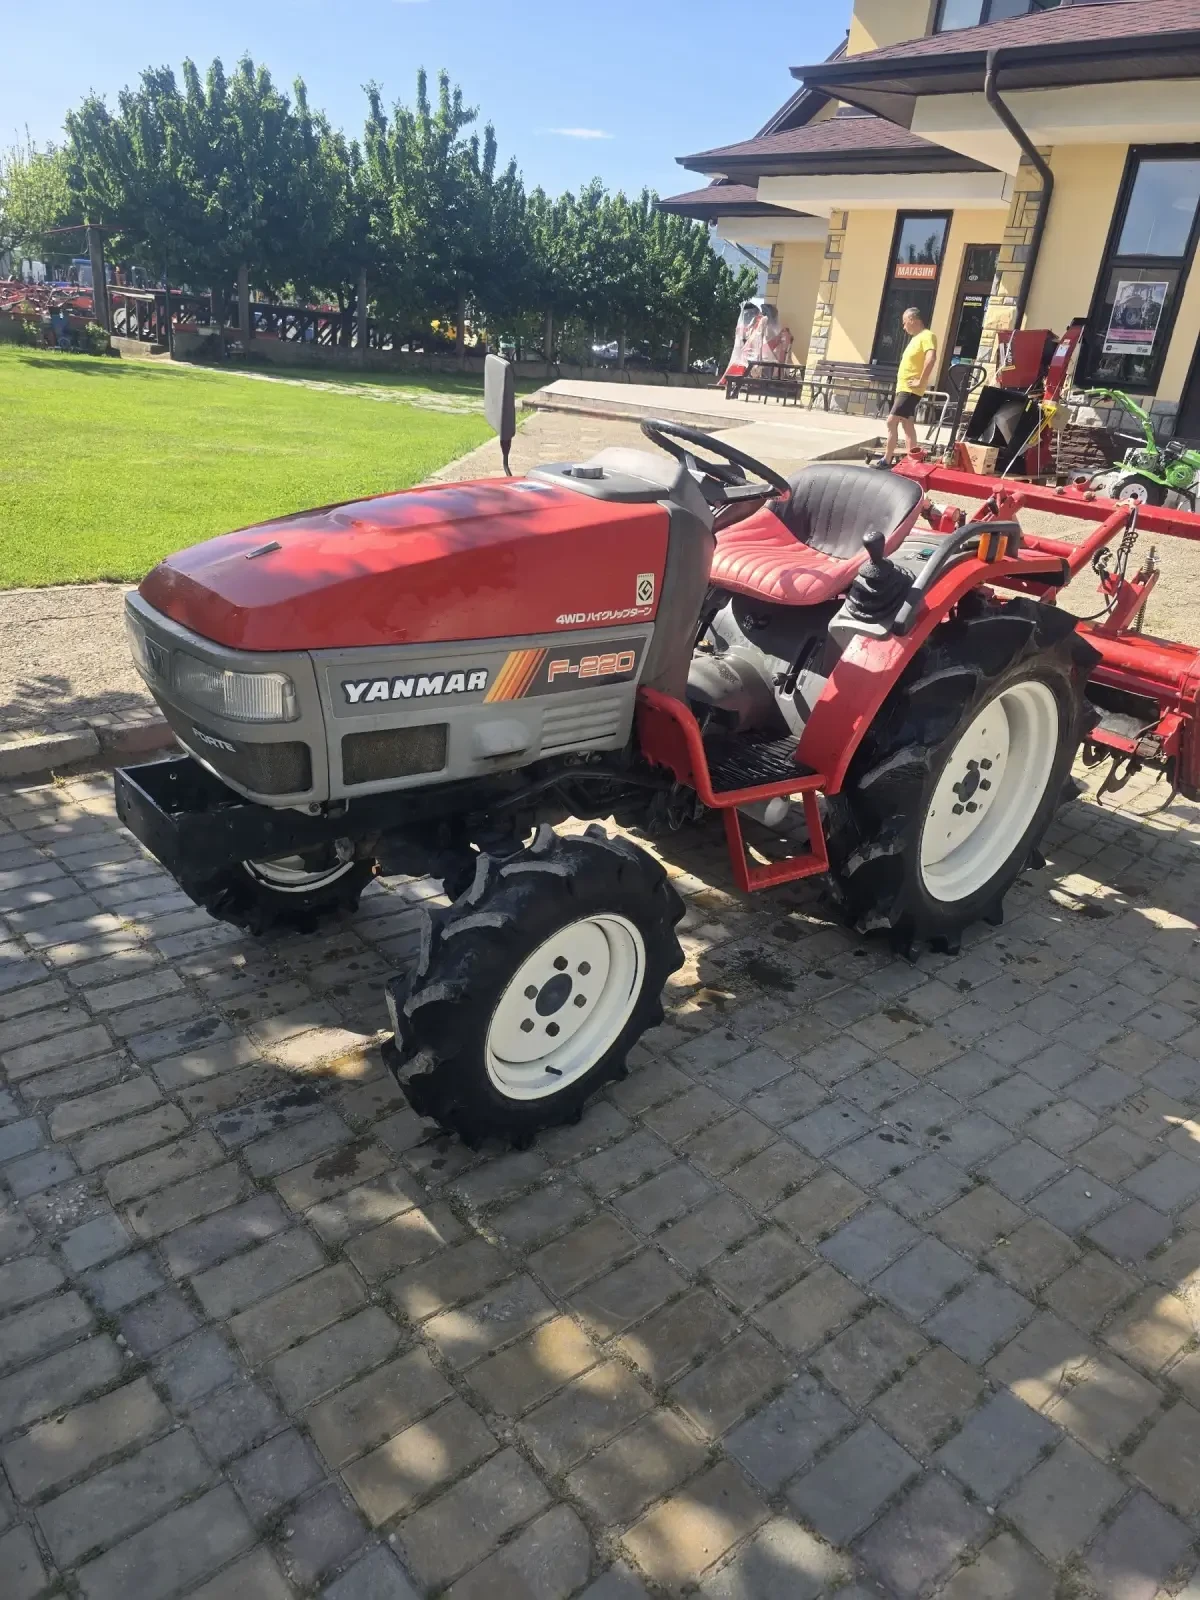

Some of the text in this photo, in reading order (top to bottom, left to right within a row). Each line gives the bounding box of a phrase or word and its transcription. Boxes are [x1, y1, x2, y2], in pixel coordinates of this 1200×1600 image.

[897, 266, 934, 277] МАГАЗИН
[555, 607, 652, 625] 4WD ハイグリップターン
[343, 650, 635, 703] YANMAR F-220
[191, 727, 237, 753] FORTE
